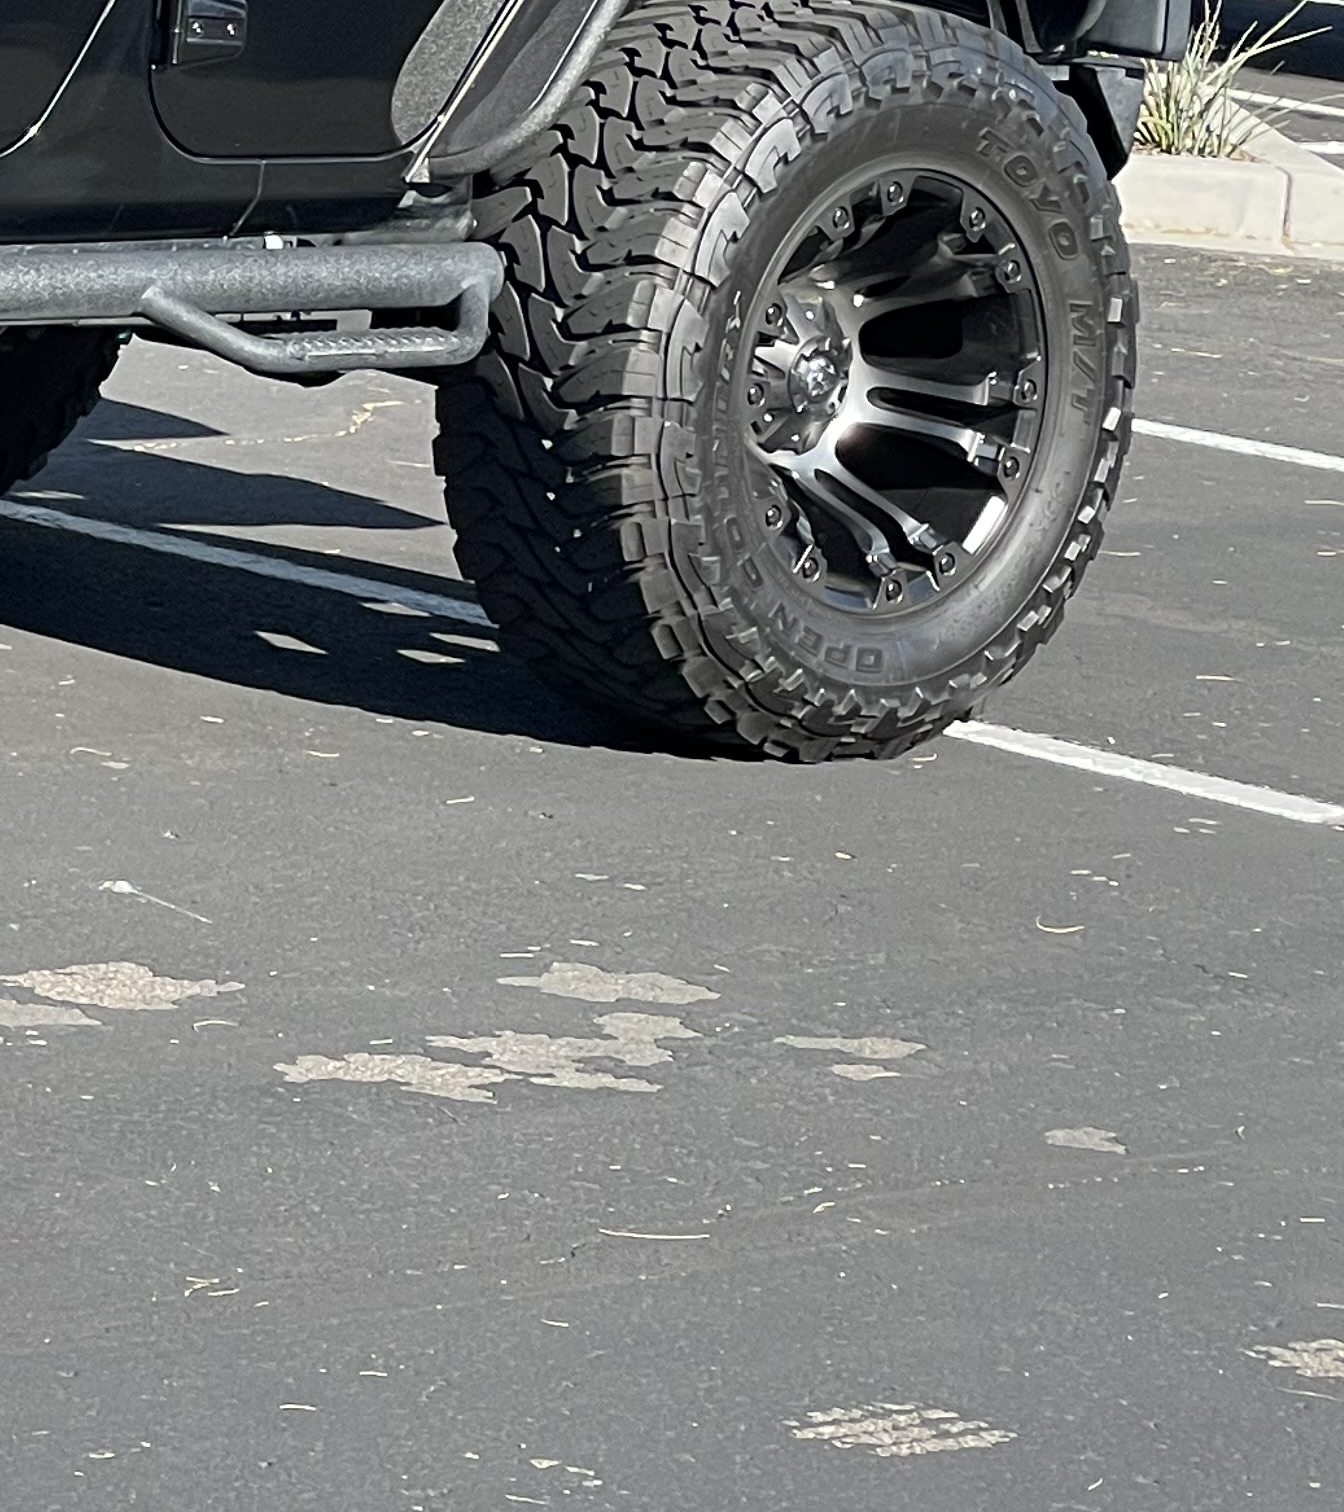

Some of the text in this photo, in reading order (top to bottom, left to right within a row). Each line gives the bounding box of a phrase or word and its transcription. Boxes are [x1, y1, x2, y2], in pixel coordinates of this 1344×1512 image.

[976, 126, 1099, 426] TOYO M/T
[769, 602, 883, 673] OPEN
